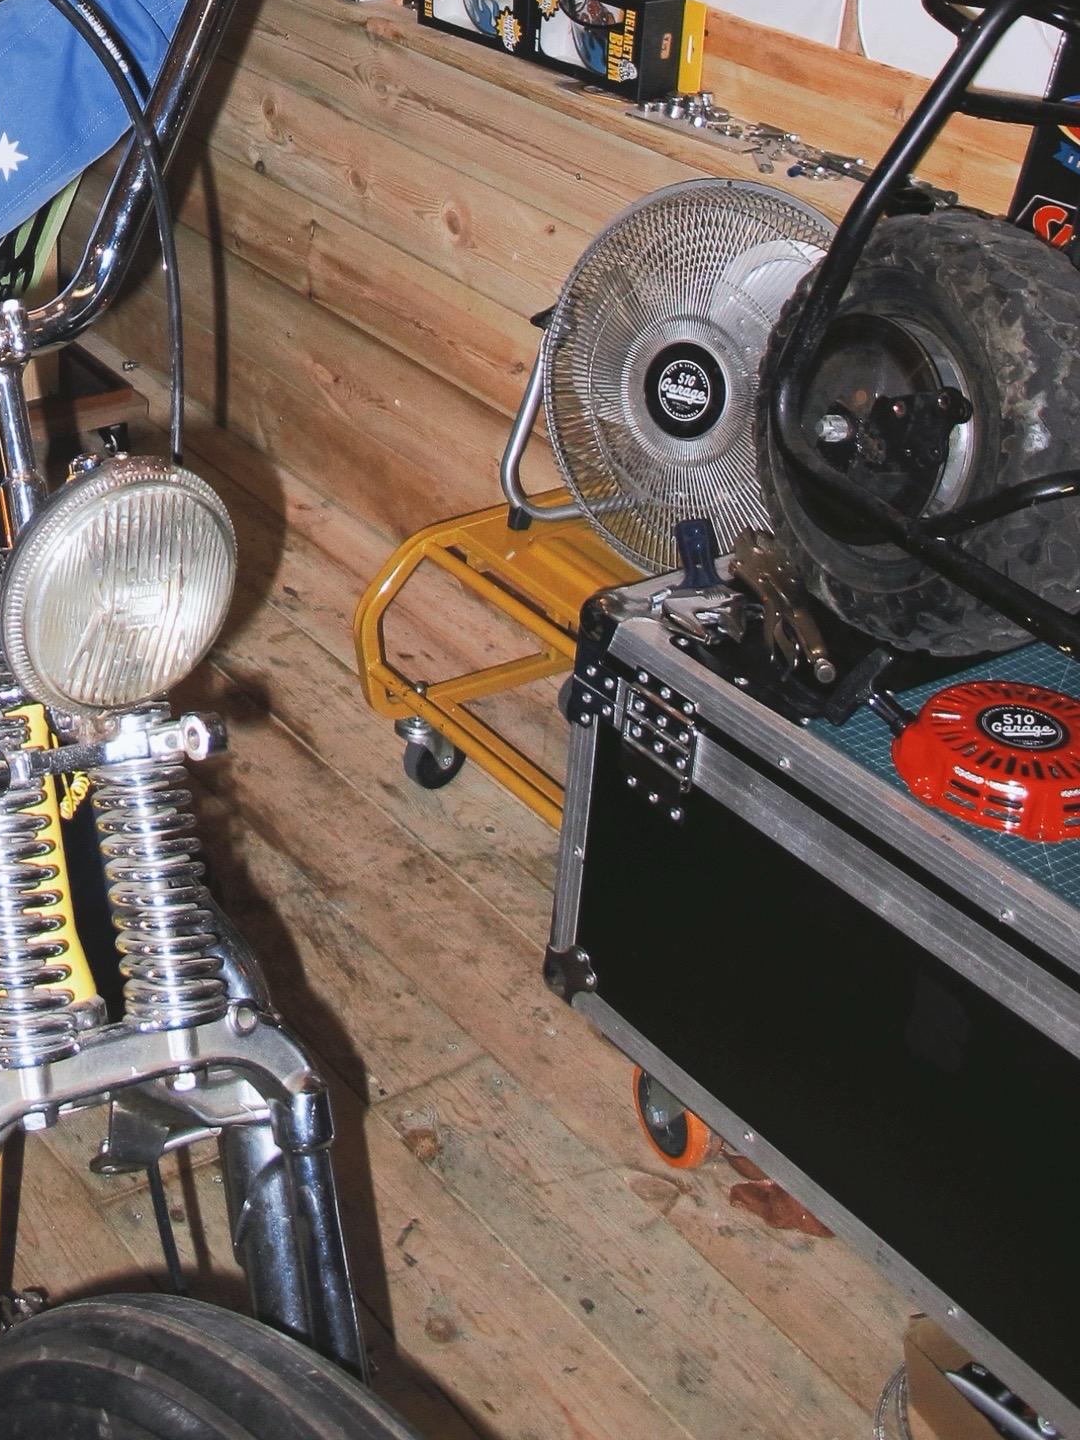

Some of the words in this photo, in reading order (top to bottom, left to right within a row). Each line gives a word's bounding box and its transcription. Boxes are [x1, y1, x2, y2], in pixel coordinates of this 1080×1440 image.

[623, 9, 636, 61] HELMET
[607, 32, 623, 82] BRIM
[677, 372, 696, 387] 510
[661, 377, 707, 405] Garage
[991, 721, 1056, 737] Garage
[1003, 713, 1035, 725] 510
